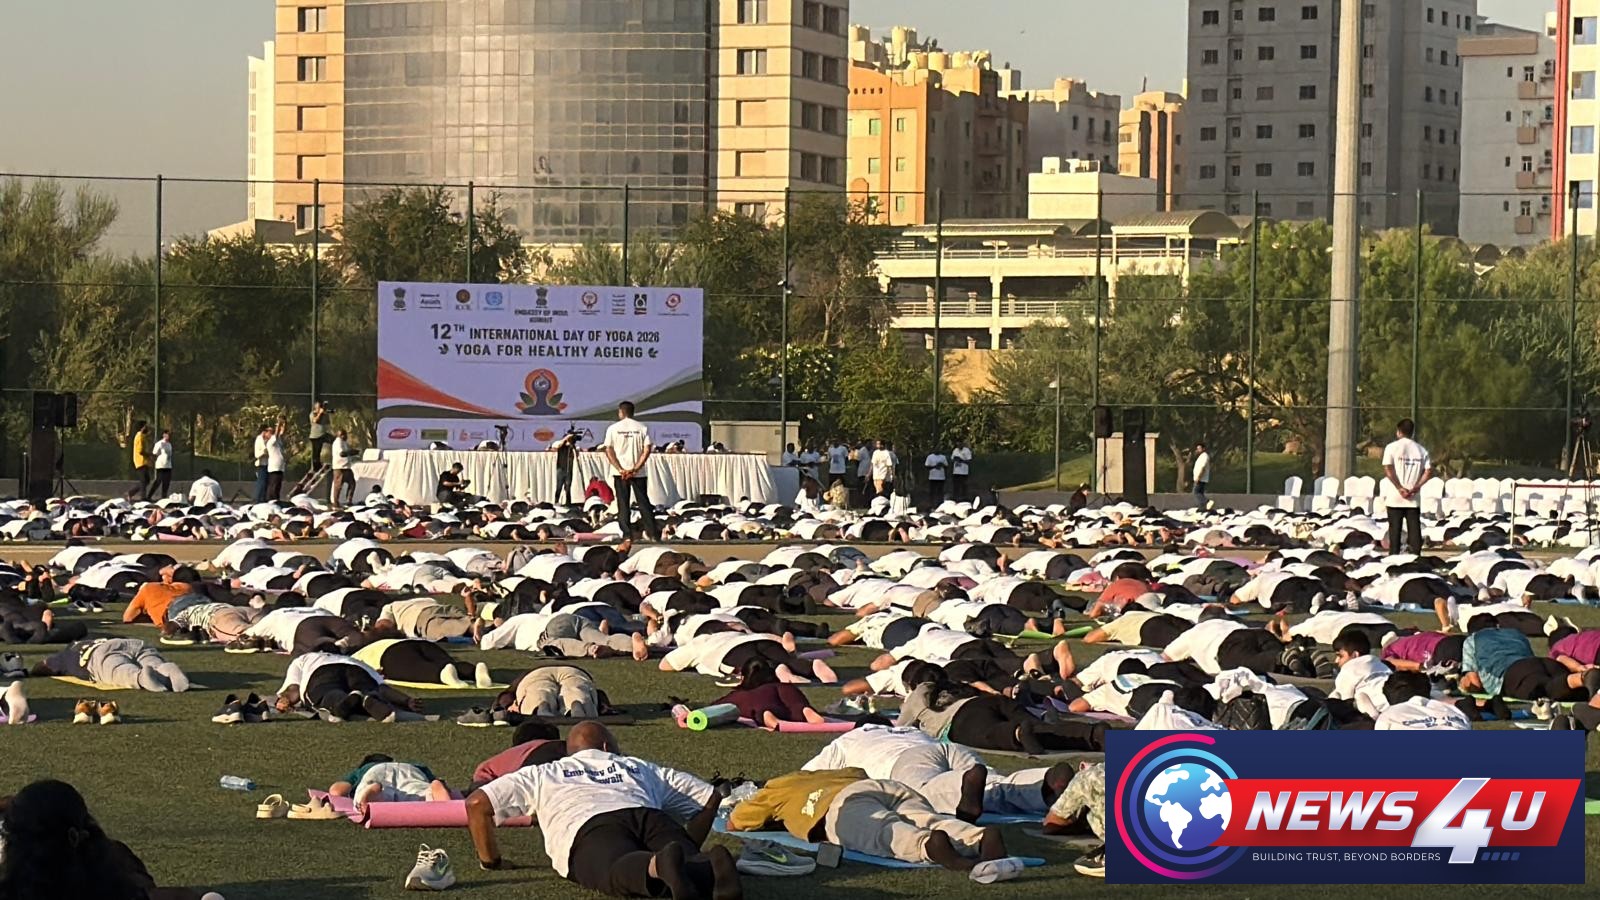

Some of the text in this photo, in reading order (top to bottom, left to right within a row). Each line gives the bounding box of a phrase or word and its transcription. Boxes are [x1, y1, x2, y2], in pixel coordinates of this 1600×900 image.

[469, 327, 560, 342] INTERNATIONAL
[563, 329, 586, 342] DAY
[588, 330, 602, 342] OF
[606, 330, 634, 343] YOGA
[455, 343, 643, 359] YOGA FOR HEALTHY AGEING
[607, 763, 617, 774] of
